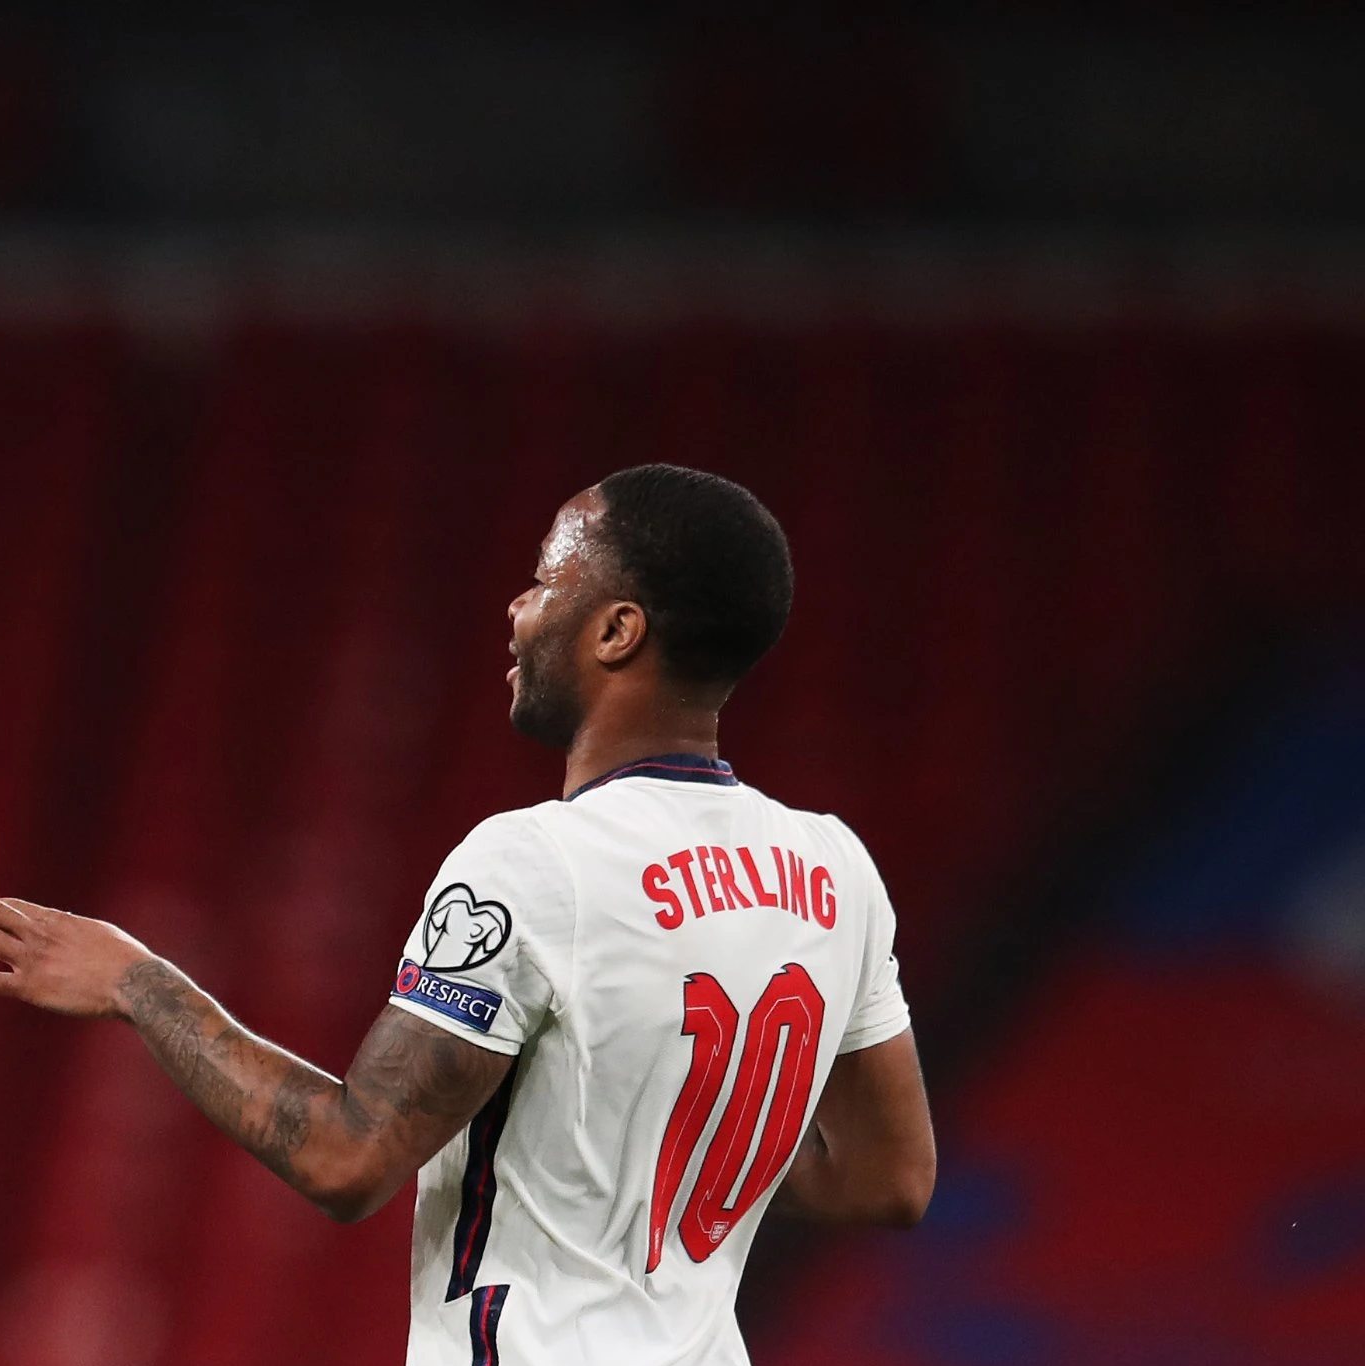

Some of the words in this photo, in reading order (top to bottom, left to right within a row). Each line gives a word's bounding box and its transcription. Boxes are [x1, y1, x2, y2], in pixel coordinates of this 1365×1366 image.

[642, 845, 837, 931] STERLING
[416, 976, 497, 1021] RESPECT
[645, 962, 826, 1274] 10
